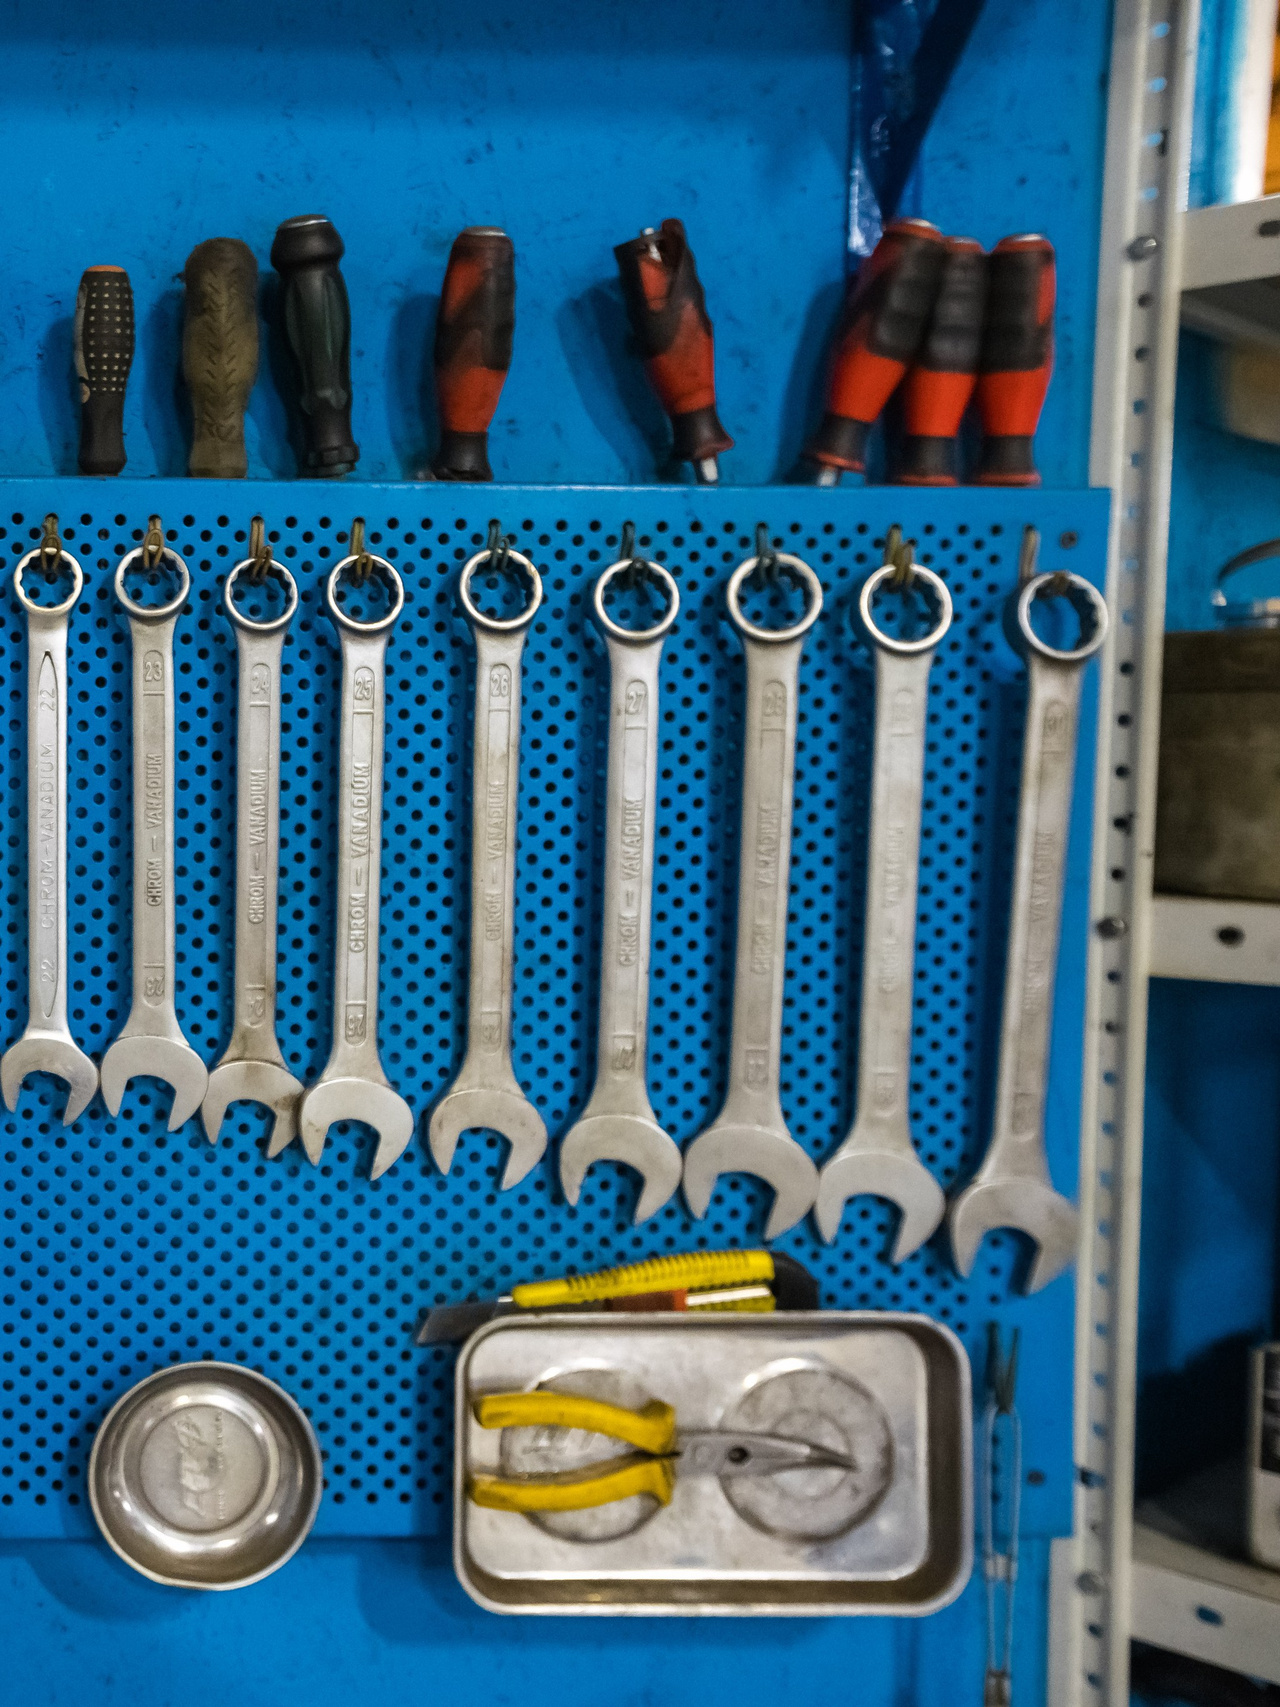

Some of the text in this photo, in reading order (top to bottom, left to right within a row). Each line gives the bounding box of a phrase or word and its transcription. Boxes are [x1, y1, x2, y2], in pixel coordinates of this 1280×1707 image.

[144, 661, 163, 682] 23
[355, 677, 372, 700] 25
[491, 674, 509, 698] 26
[39, 688, 56, 712] 22
[626, 691, 646, 715] 27
[40, 959, 56, 983] 22
[346, 1014, 365, 1037] 25
